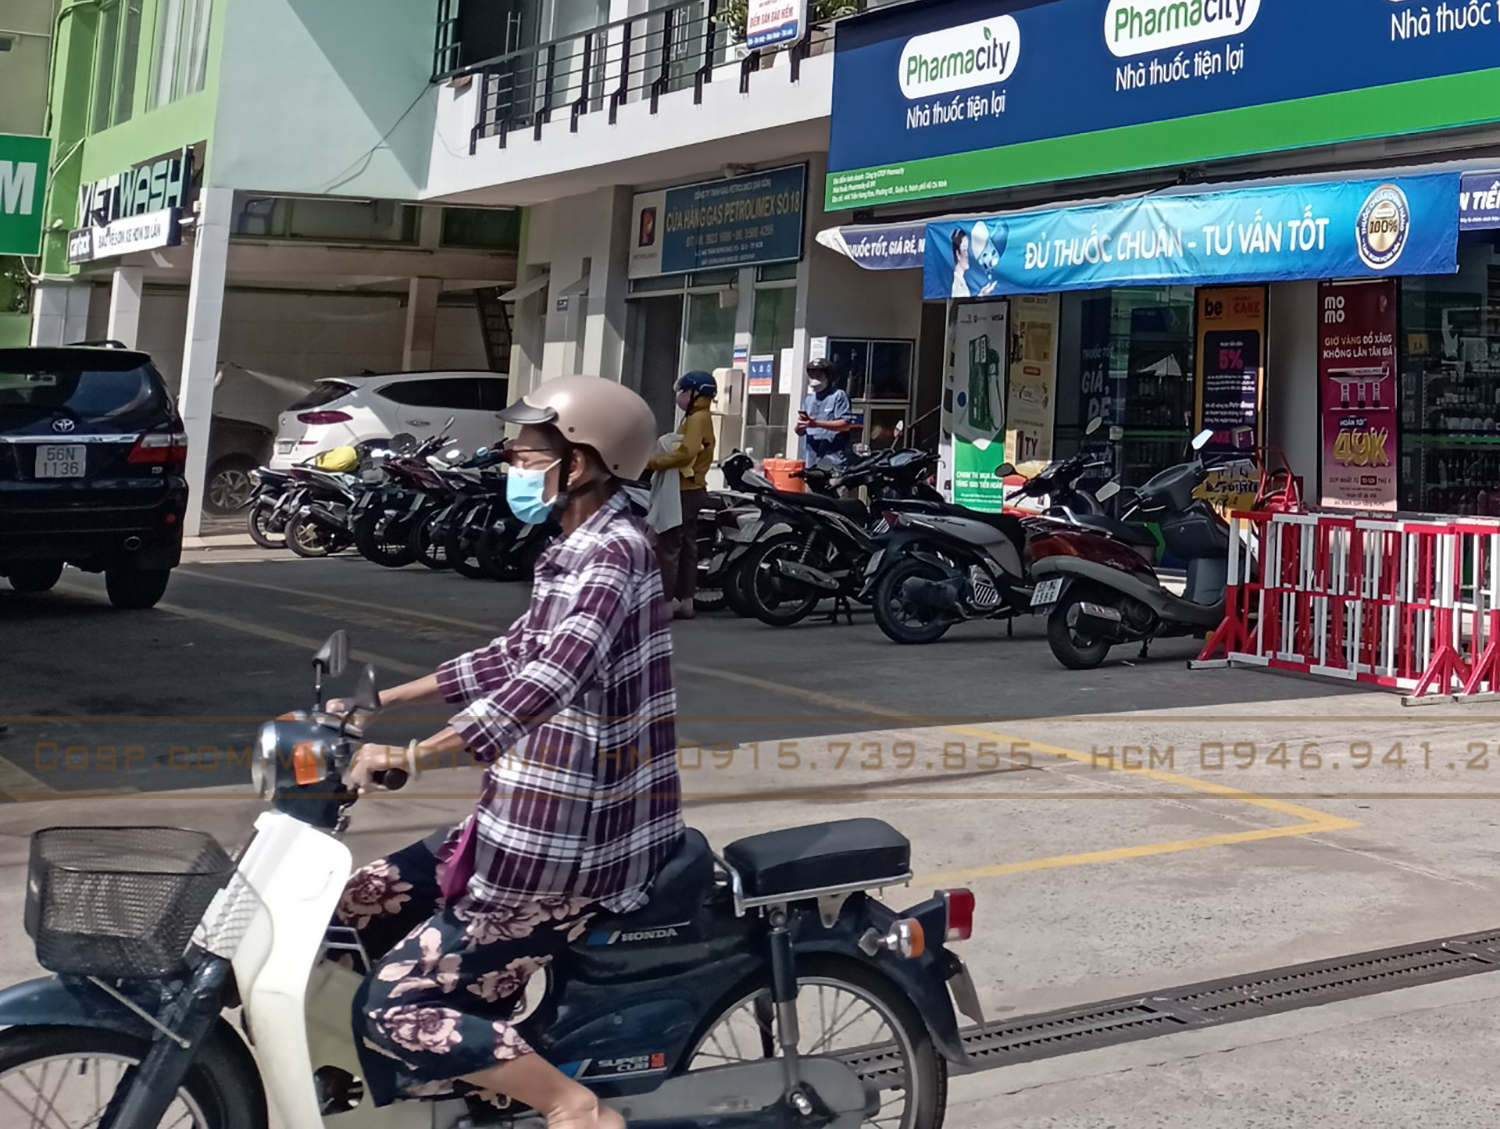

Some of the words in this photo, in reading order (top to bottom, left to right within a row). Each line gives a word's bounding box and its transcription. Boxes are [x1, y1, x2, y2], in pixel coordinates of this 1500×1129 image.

[1391, 8, 1430, 42] Nhà
[906, 27, 1011, 86] Pharmacity
[1024, 232, 1050, 270] ĐỦ
[1053, 221, 1113, 267] THUỐC
[1202, 220, 1235, 254] TƯ
[1239, 209, 1280, 254] VẤN
[1288, 203, 1329, 251] TỐT
[621, 928, 678, 942] HONDA
